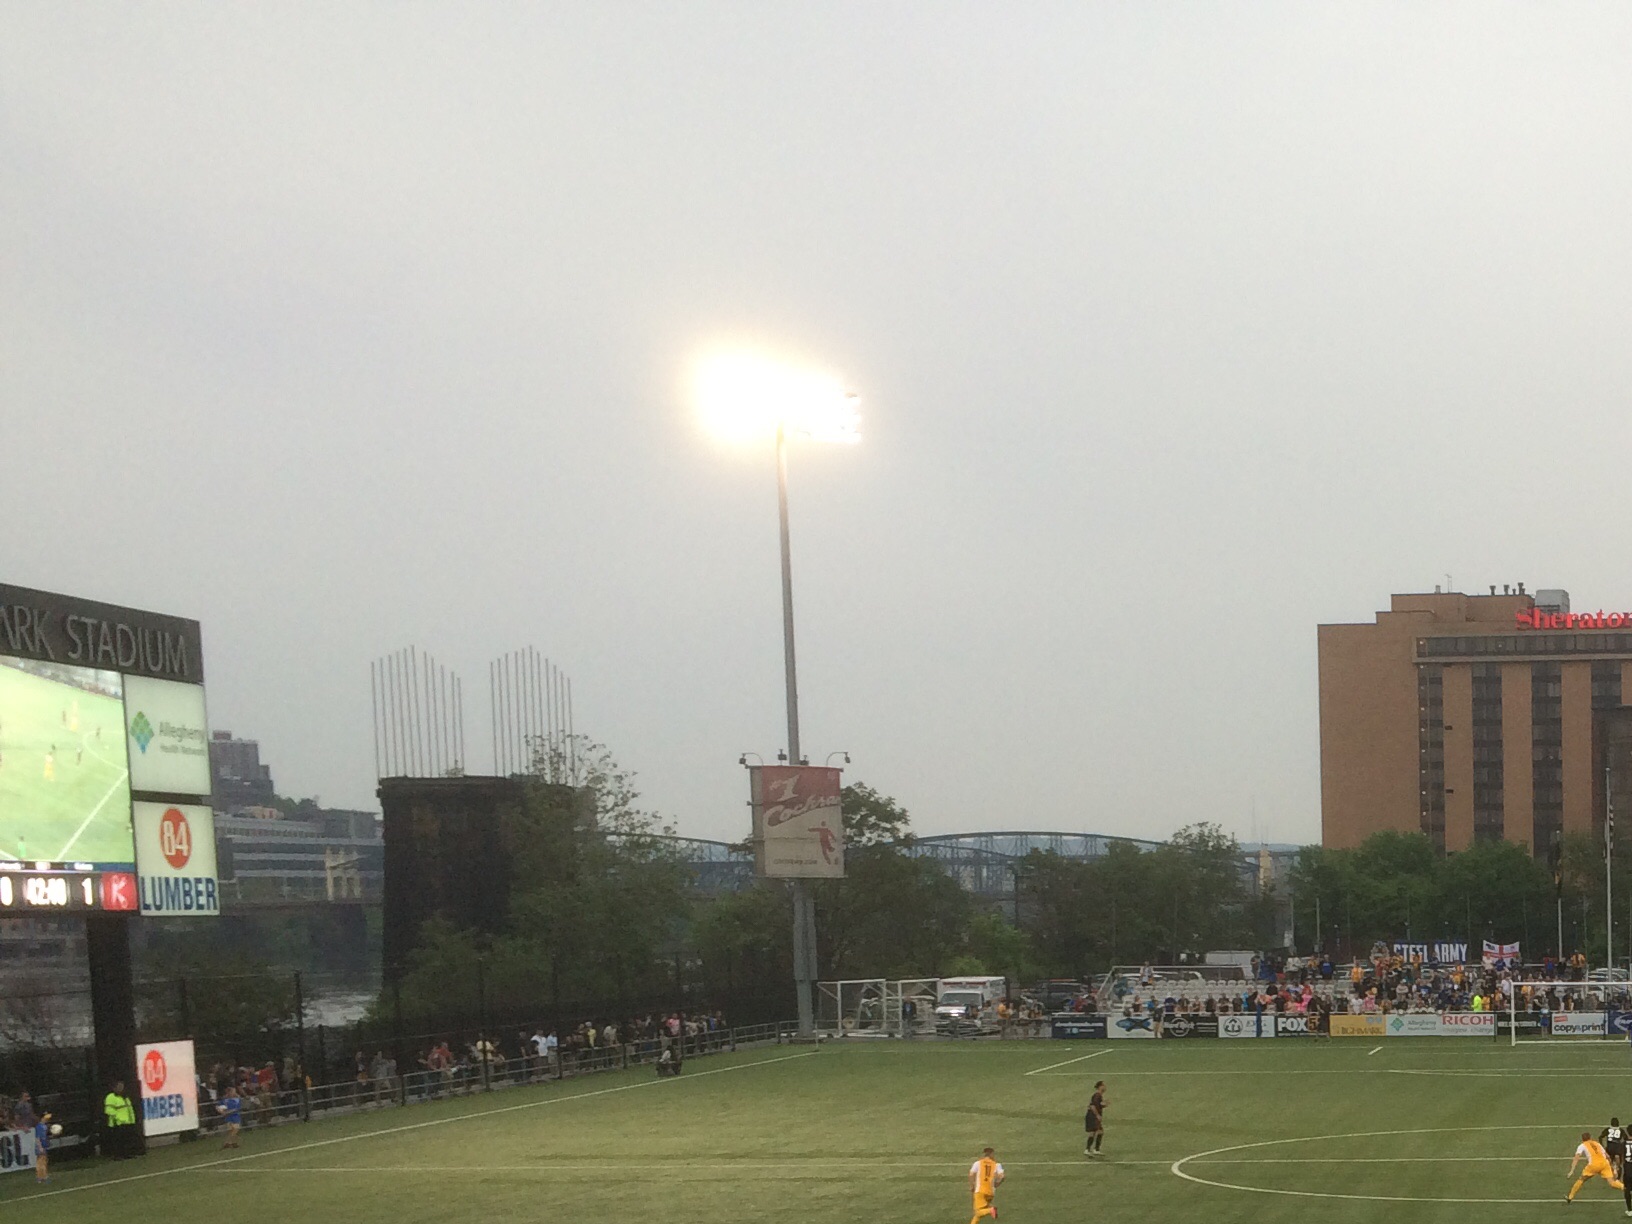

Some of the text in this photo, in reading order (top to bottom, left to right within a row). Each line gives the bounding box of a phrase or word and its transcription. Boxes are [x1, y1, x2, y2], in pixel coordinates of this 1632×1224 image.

[66, 614, 188, 676] STADIUM
[162, 820, 190, 857] 84
[141, 875, 218, 911] LUMBER
[1394, 943, 1467, 963] STEEL ARMY
[1277, 1017, 1308, 1032] FOX
[1442, 1015, 1494, 1026] RICOH
